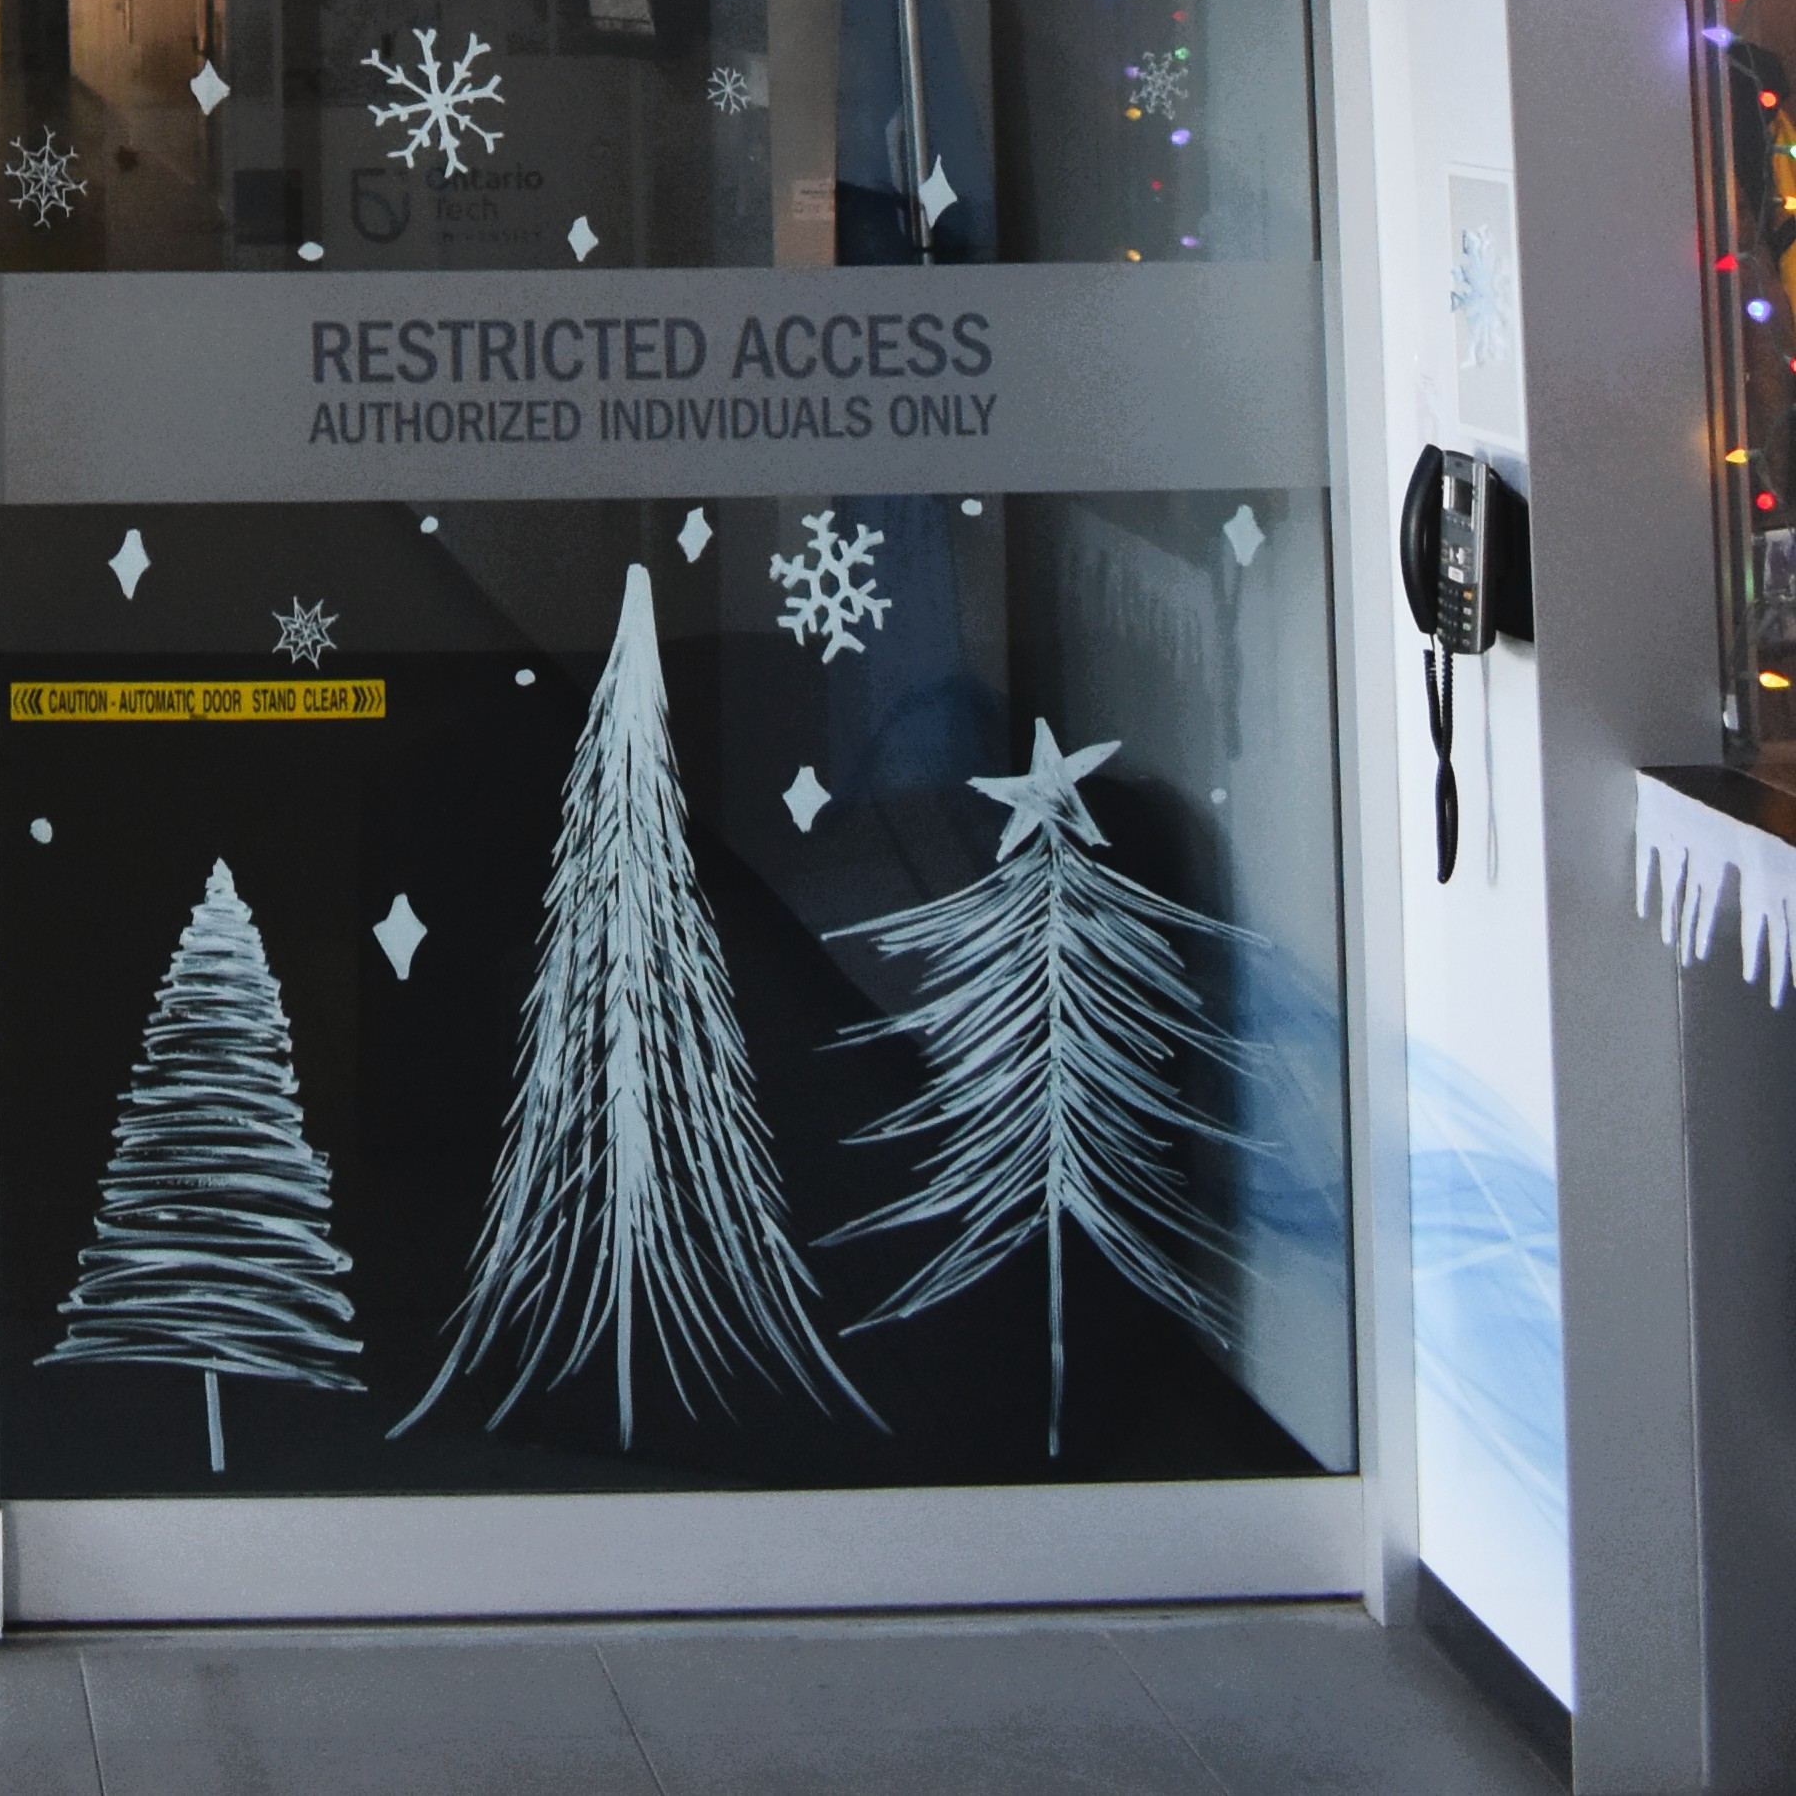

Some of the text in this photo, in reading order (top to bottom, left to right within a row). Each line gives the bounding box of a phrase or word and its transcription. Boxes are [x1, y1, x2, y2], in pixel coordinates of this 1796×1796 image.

[311, 313, 994, 383] RESTRICTED ACCESS
[308, 393, 998, 445] AUTHORIZED INDIVIDUALS ONLY
[203, 688, 242, 713] DOOR
[252, 688, 296, 713] STAND
[303, 687, 348, 712] CLEAR
